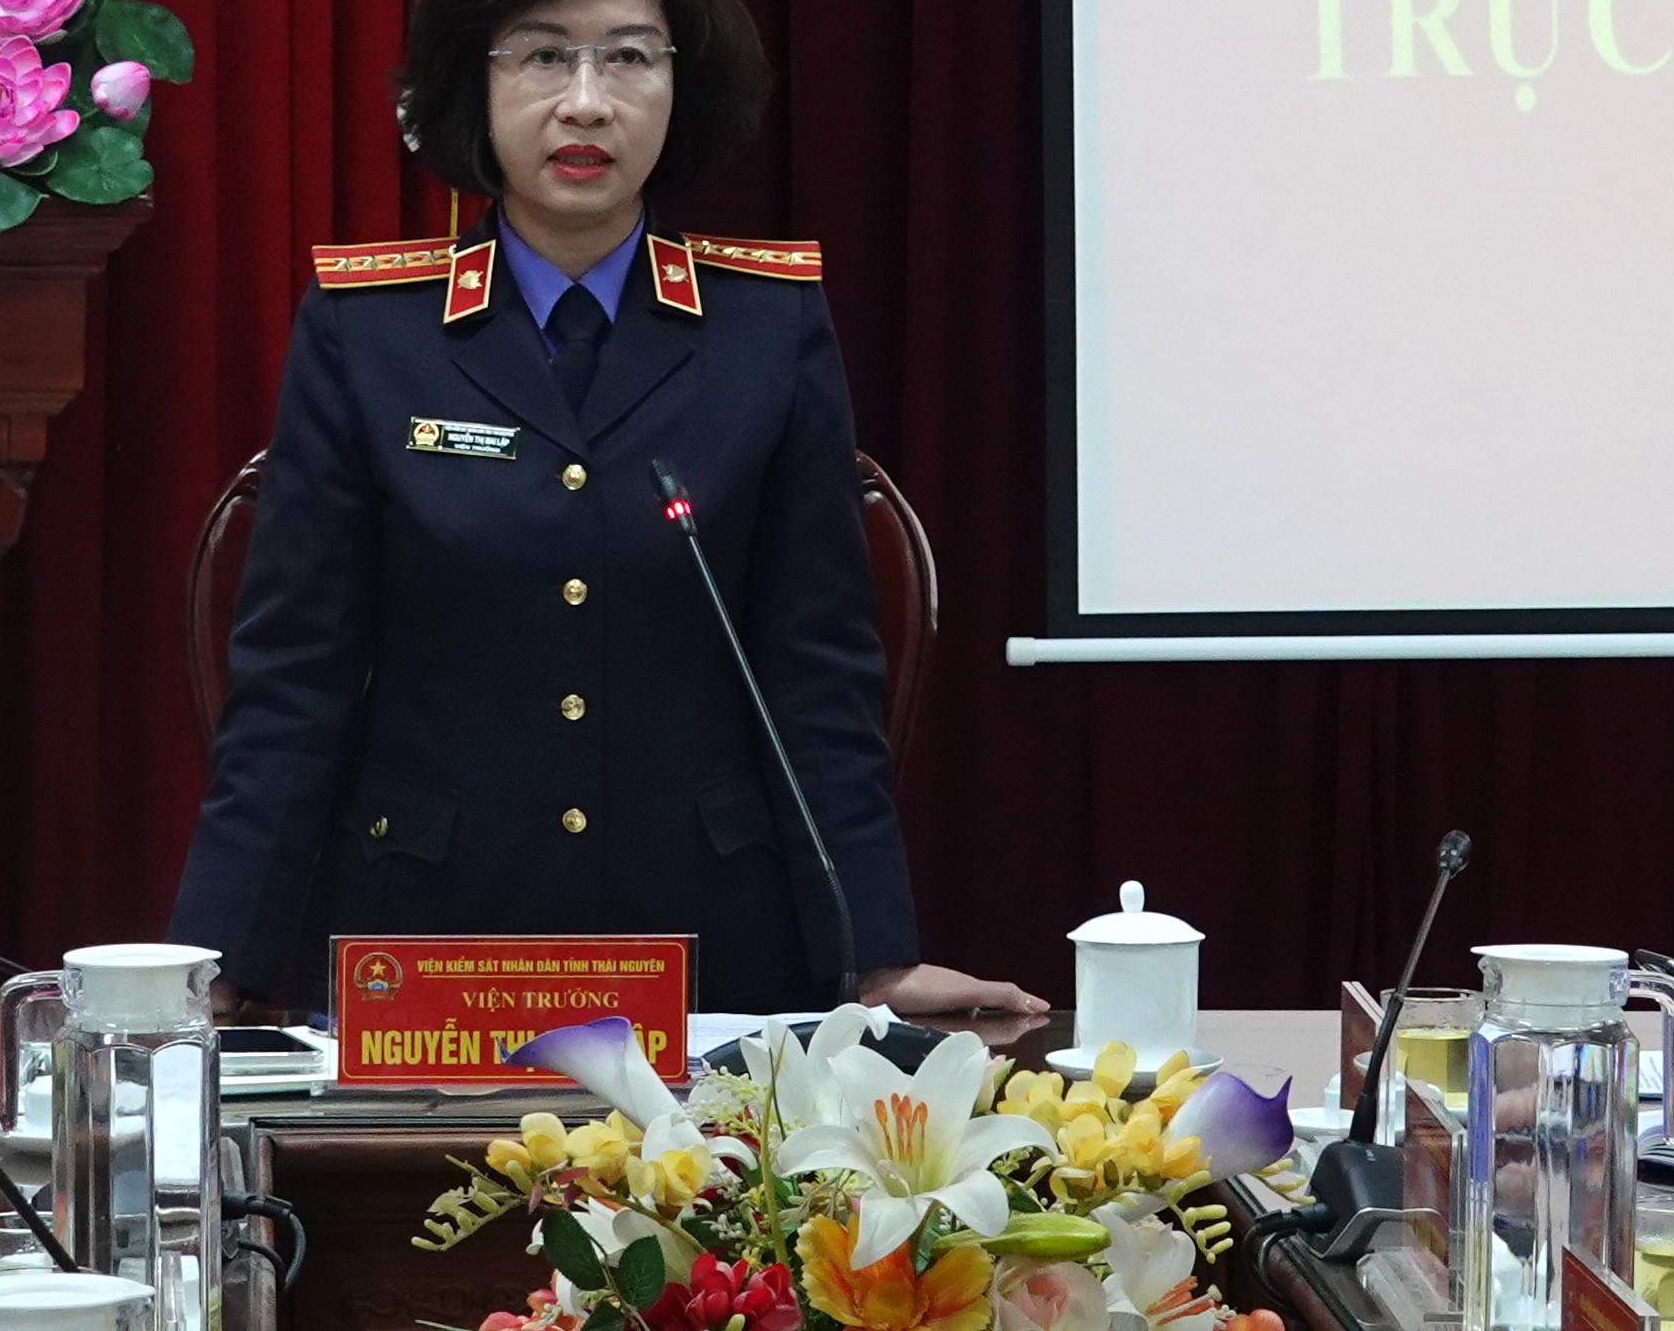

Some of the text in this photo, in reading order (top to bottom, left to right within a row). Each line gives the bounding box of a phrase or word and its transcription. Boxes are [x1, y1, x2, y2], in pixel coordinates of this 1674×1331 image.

[417, 956, 665, 974] VIỆN KIỂM SÁT NHÂN DÂN TỈNH THÁI NGUYÊN
[462, 987, 620, 1012] VIỆN TRƯỞNG
[361, 1017, 481, 1065] NGUYỄN
